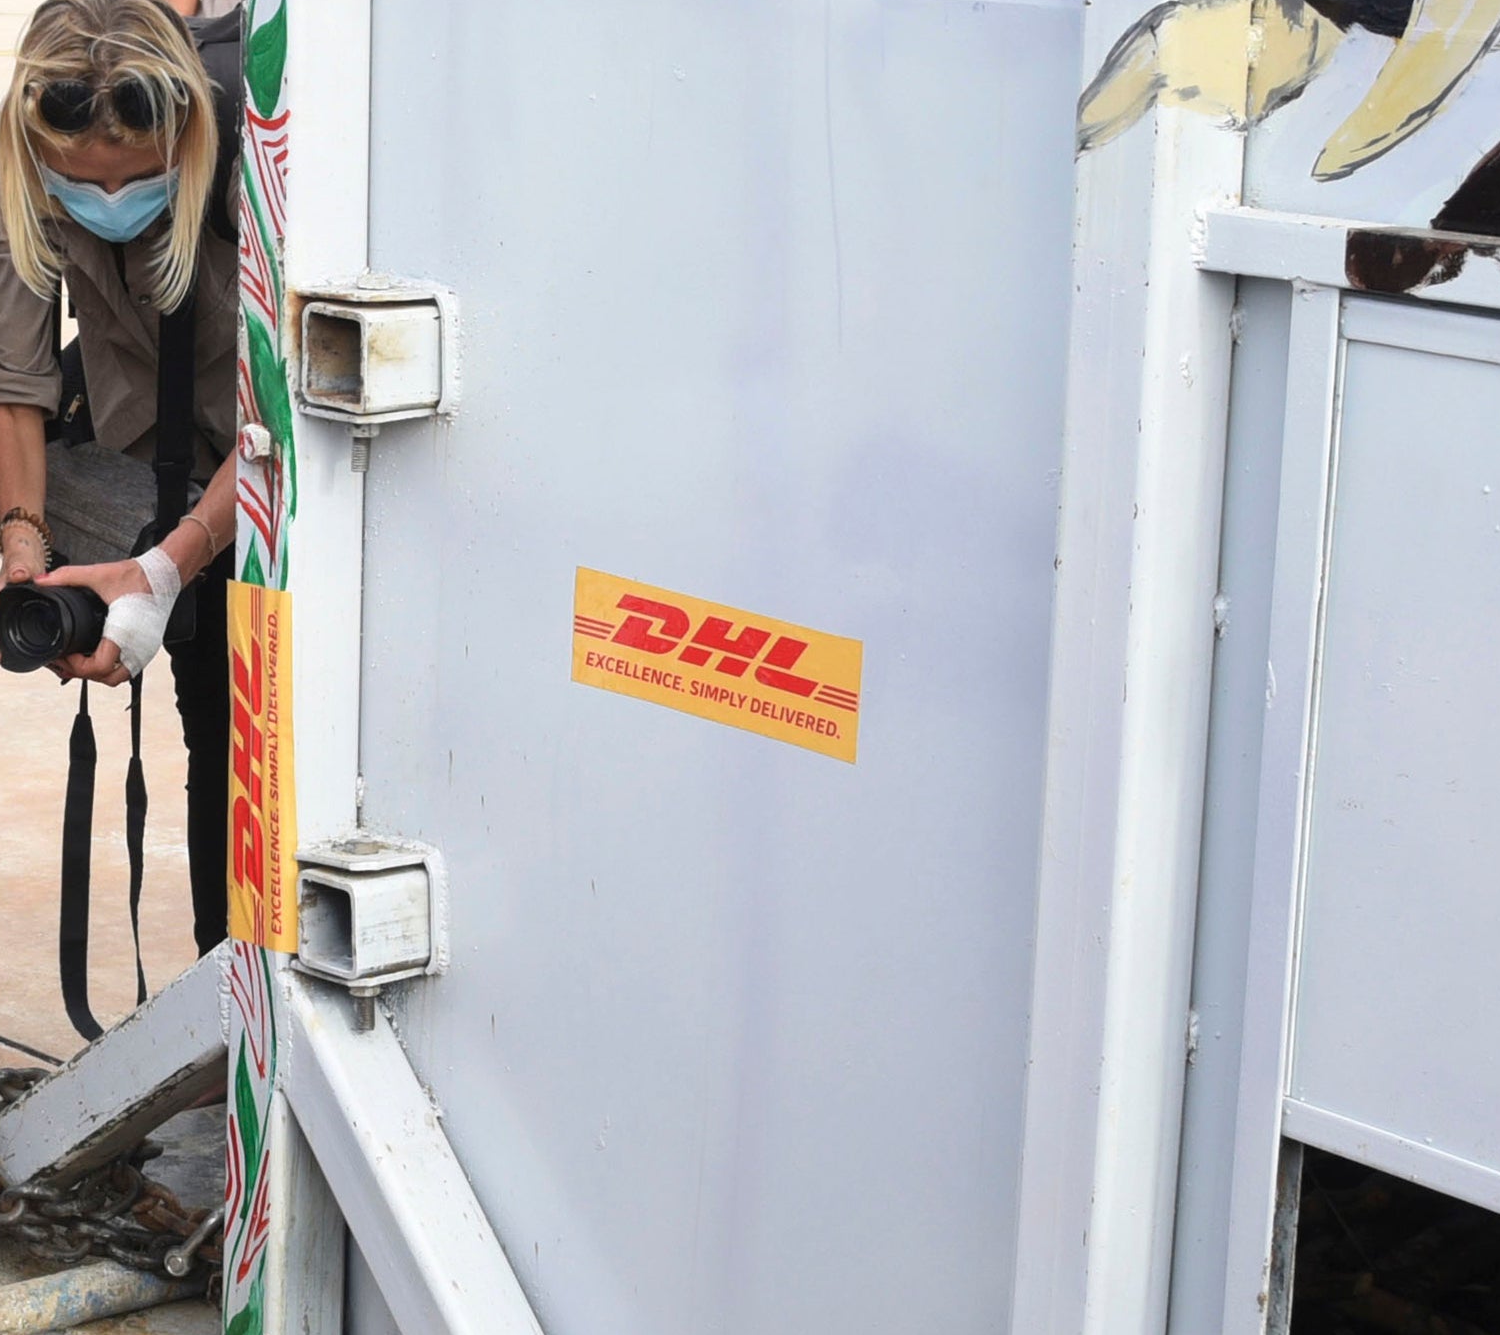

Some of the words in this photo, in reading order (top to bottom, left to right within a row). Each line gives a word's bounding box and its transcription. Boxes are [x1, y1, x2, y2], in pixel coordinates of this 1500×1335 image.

[267, 610, 279, 723] DELIVERED.
[585, 651, 686, 694] EXCELLENCE.
[689, 679, 749, 710] SIMPLY
[749, 697, 842, 741] DELIVERED.
[611, 593, 819, 699] DHL
[232, 636, 264, 900] DHL
[267, 730, 281, 802] SIMPLY
[269, 808, 283, 935] EXCELLENCE.
